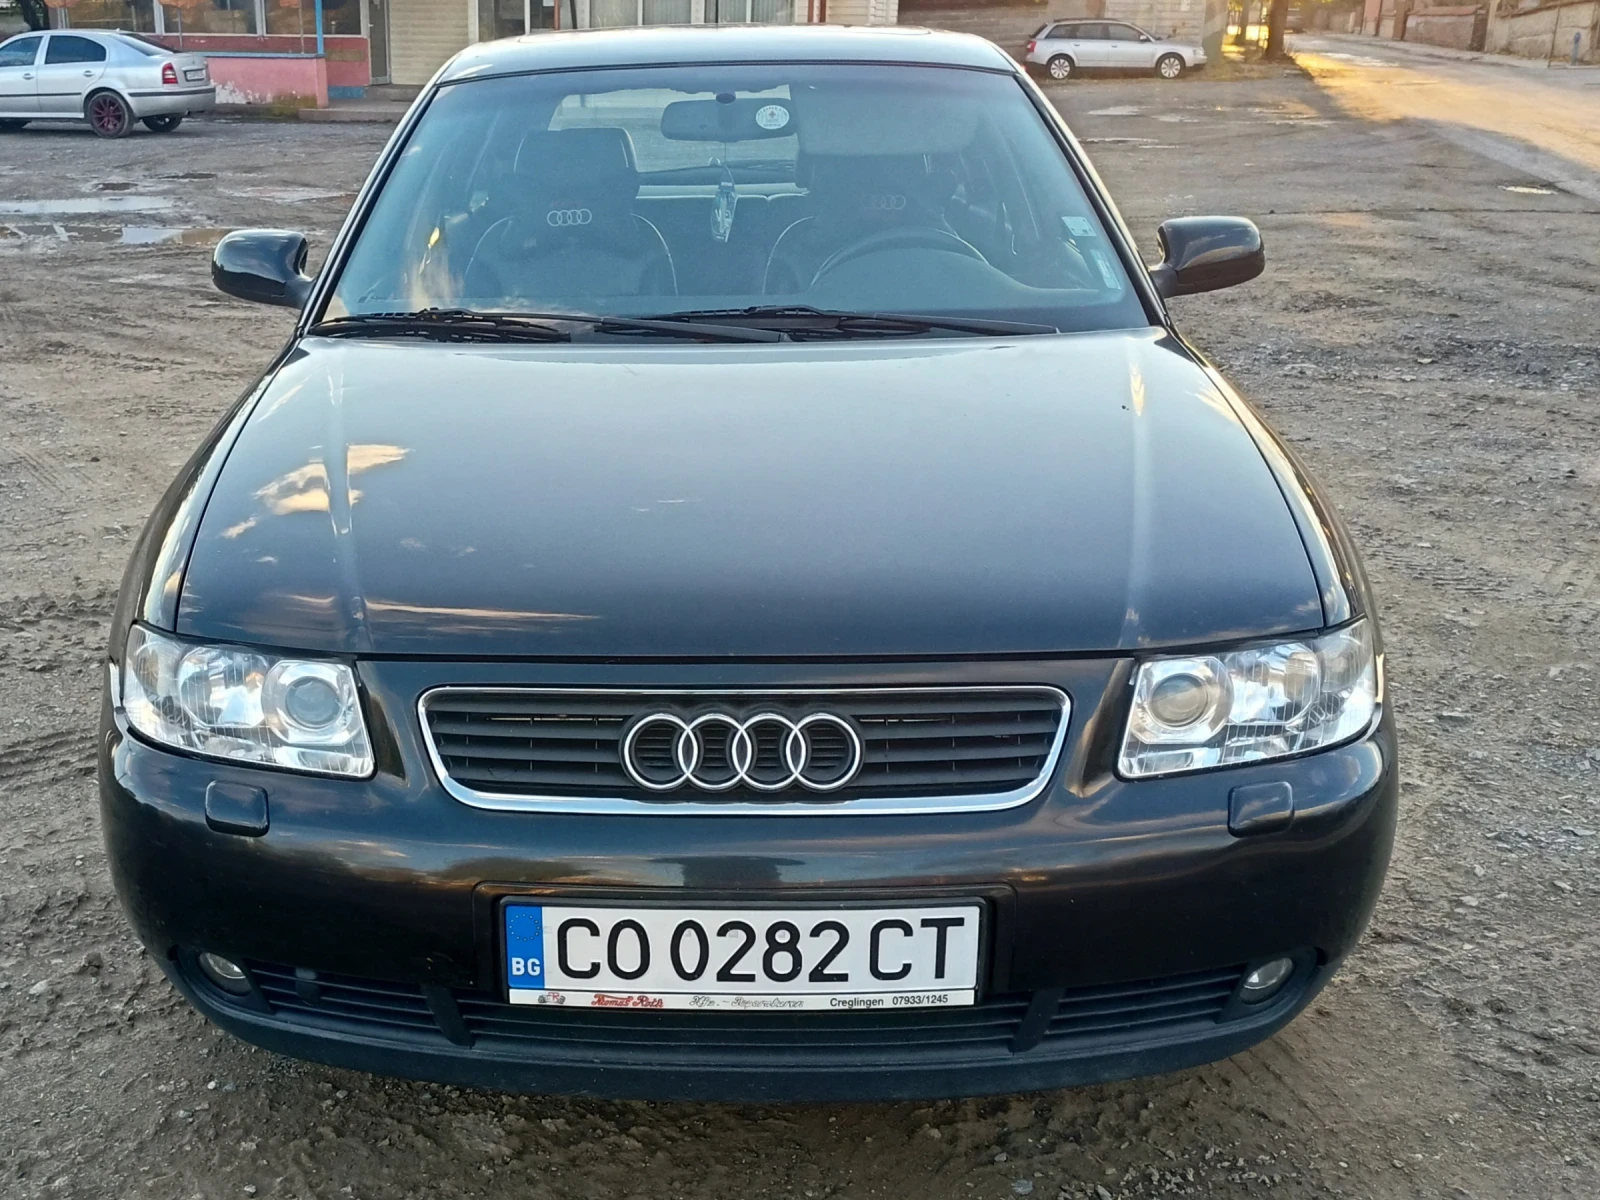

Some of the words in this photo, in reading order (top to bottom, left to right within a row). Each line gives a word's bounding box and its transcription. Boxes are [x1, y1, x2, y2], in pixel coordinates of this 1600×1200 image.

[557, 917, 651, 980] CO
[670, 919, 850, 982] 0282
[869, 917, 965, 981] CT
[511, 957, 541, 976] BG
[829, 997, 884, 1009] Creglingen
[892, 994, 948, 1006] 07933/1245
